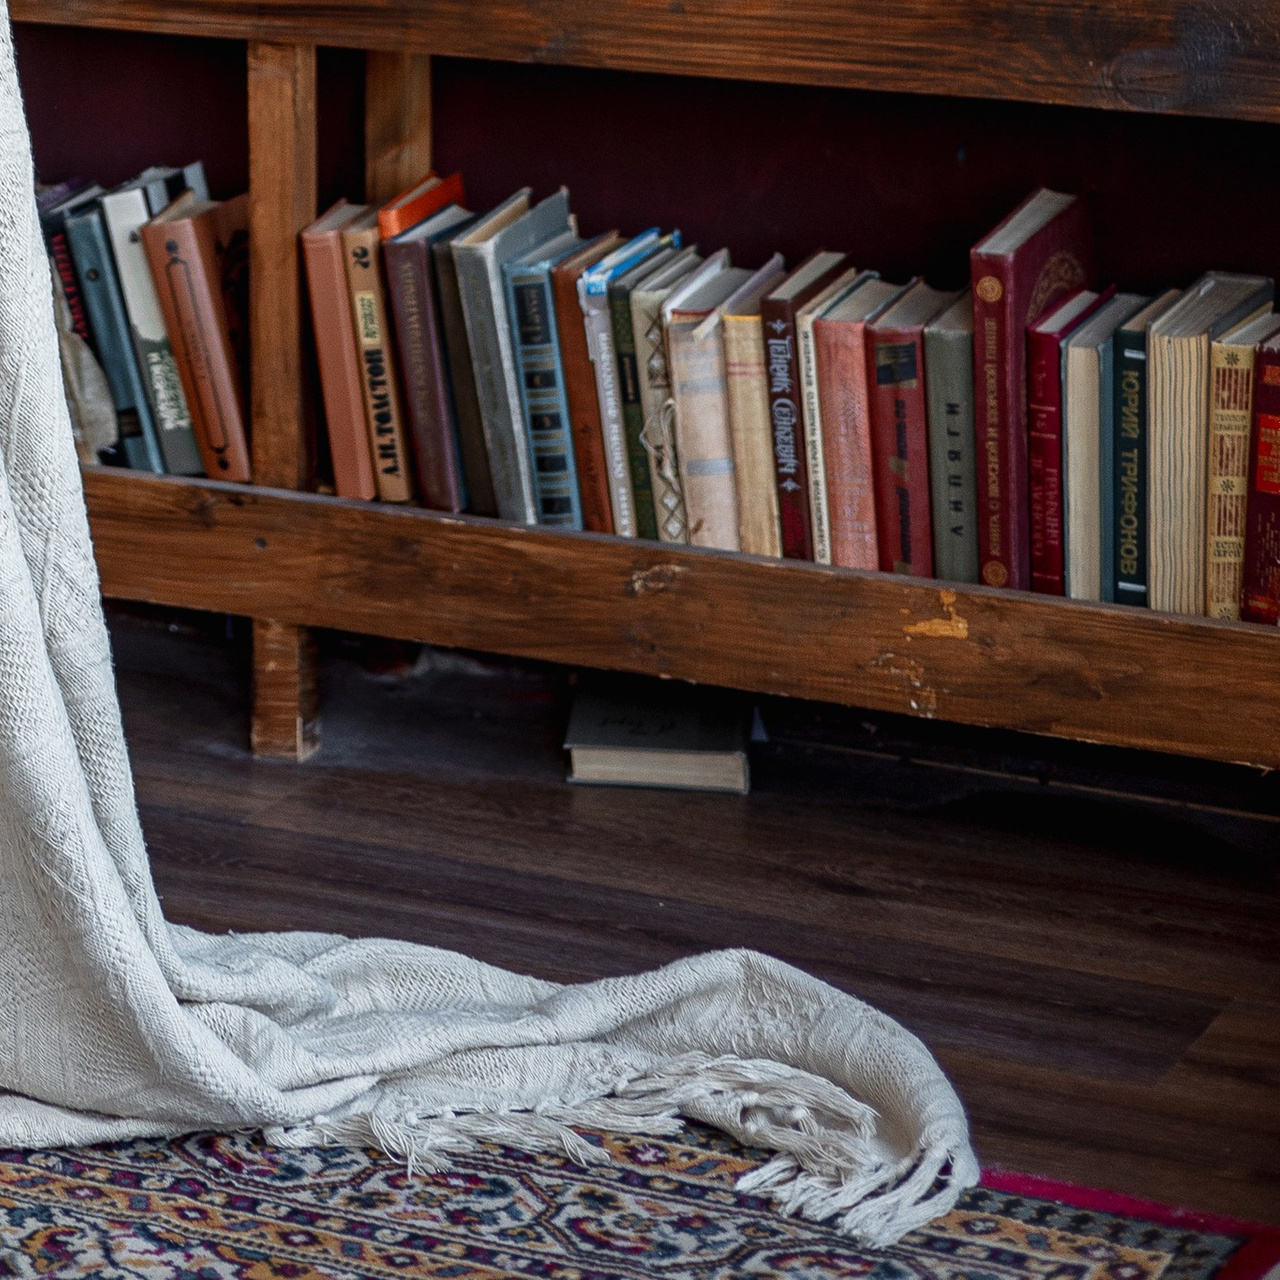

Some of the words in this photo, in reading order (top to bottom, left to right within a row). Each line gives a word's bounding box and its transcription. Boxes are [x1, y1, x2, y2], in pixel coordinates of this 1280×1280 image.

[767, 336, 793, 392] ГЕНРИК
[771, 397, 798, 475] СЕНКЕВИЧ
[1121, 370, 1140, 438] ЮРИЙ
[1120, 448, 1140, 574] ТРИФОНОВ
